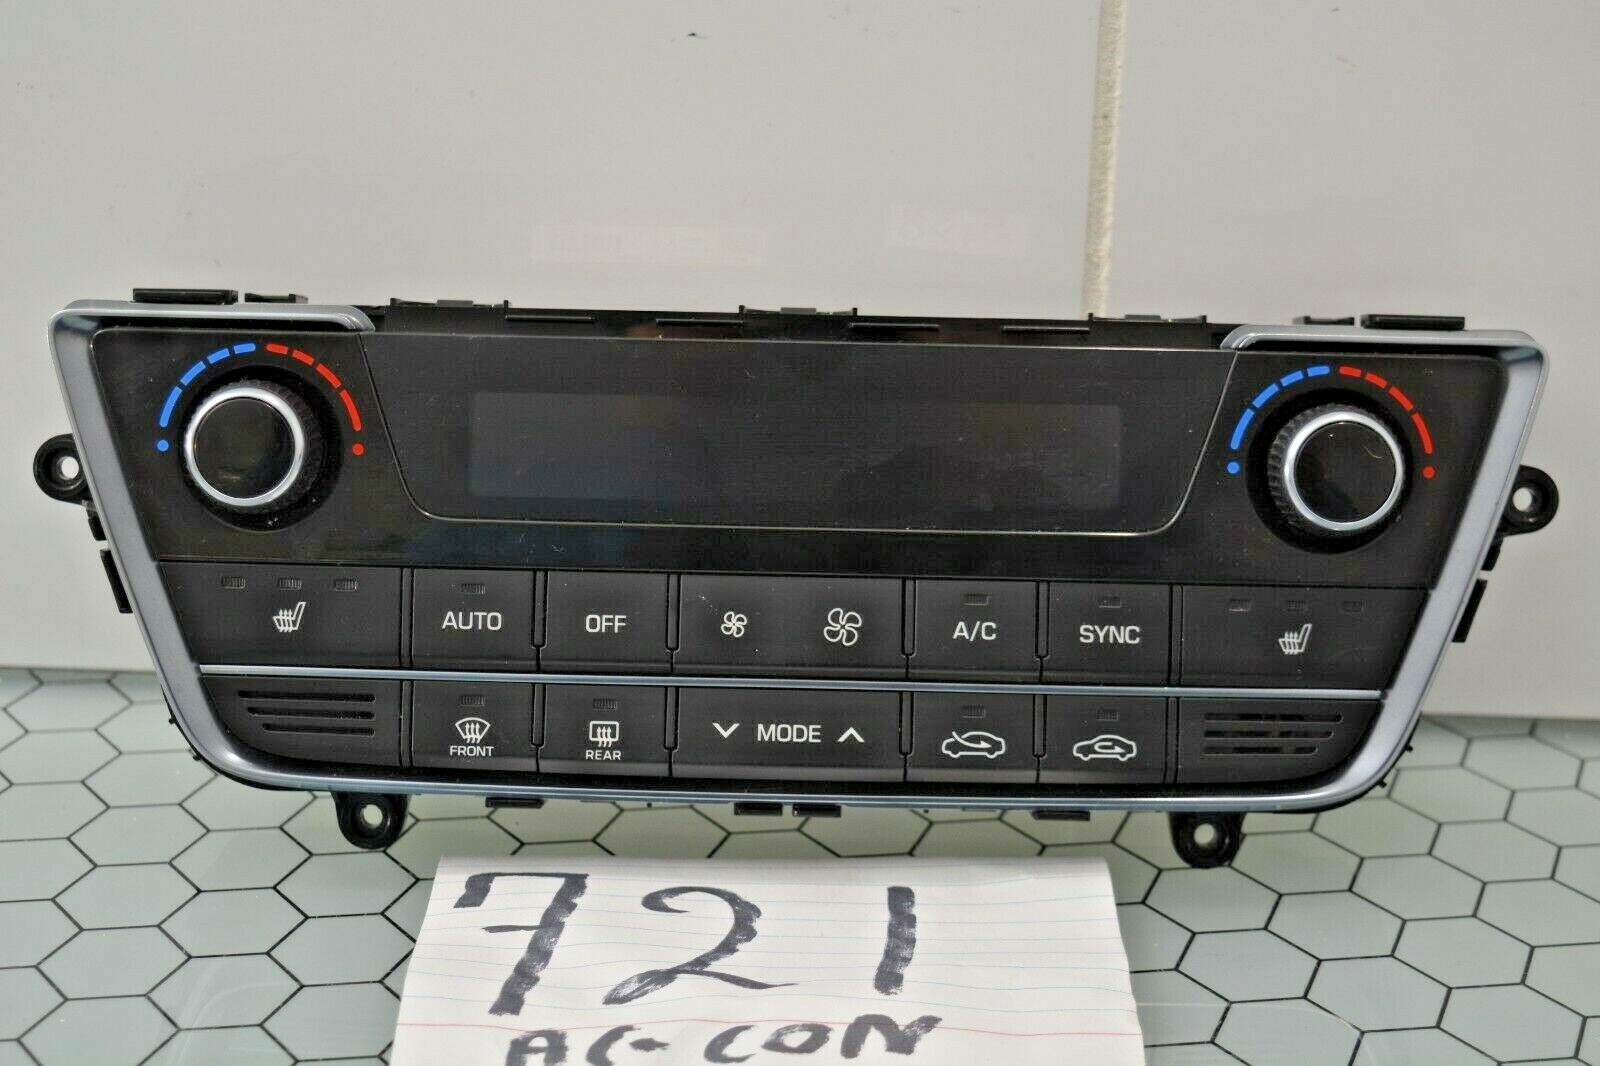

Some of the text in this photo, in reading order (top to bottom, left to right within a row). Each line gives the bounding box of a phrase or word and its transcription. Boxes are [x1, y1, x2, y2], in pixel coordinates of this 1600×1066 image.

[441, 611, 502, 631] AUTO
[585, 614, 627, 633] OFF
[953, 621, 997, 641] A/C
[1079, 624, 1140, 645] SYNC
[756, 723, 822, 743] MODE
[449, 745, 494, 758] FRONT
[585, 750, 622, 761] REAR
[453, 872, 917, 1016] 721
